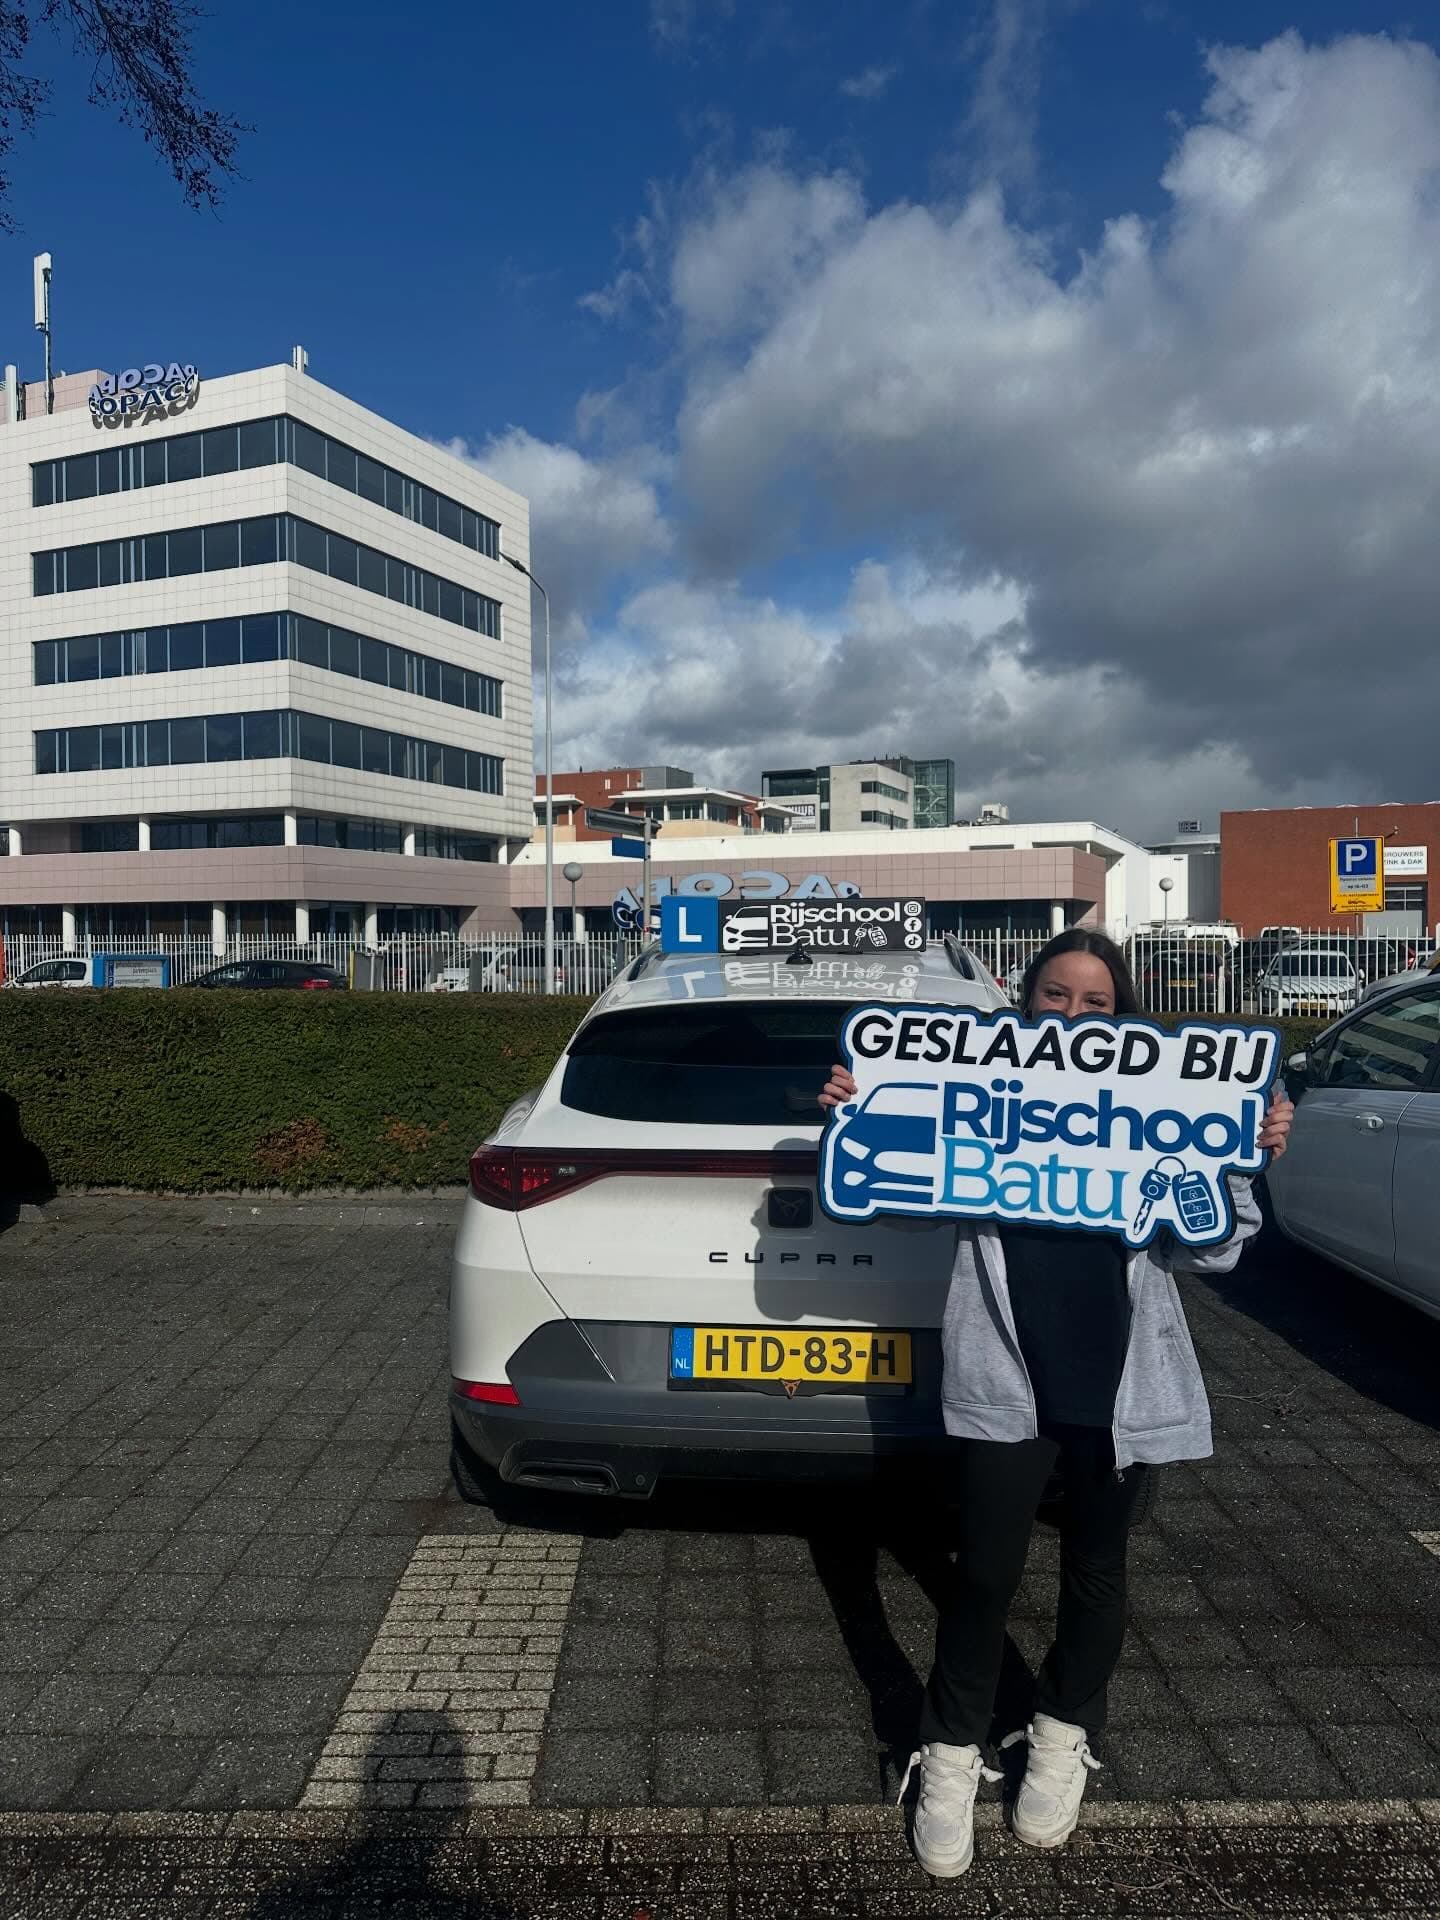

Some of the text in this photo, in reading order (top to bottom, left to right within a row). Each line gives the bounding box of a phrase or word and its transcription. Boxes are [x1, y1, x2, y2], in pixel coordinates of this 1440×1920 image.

[1345, 843, 1368, 872] P
[679, 906, 702, 942] L
[770, 901, 901, 927] Rijschool
[770, 924, 850, 946] Batu
[851, 1015, 1268, 1084] GESLAAGD BIJ
[942, 1078, 1257, 1160] Rijschool
[938, 1136, 1131, 1221] Batu
[708, 1251, 873, 1266] CUPRA
[675, 1358, 690, 1370] NL
[705, 1334, 896, 1376] HTD-83-H
